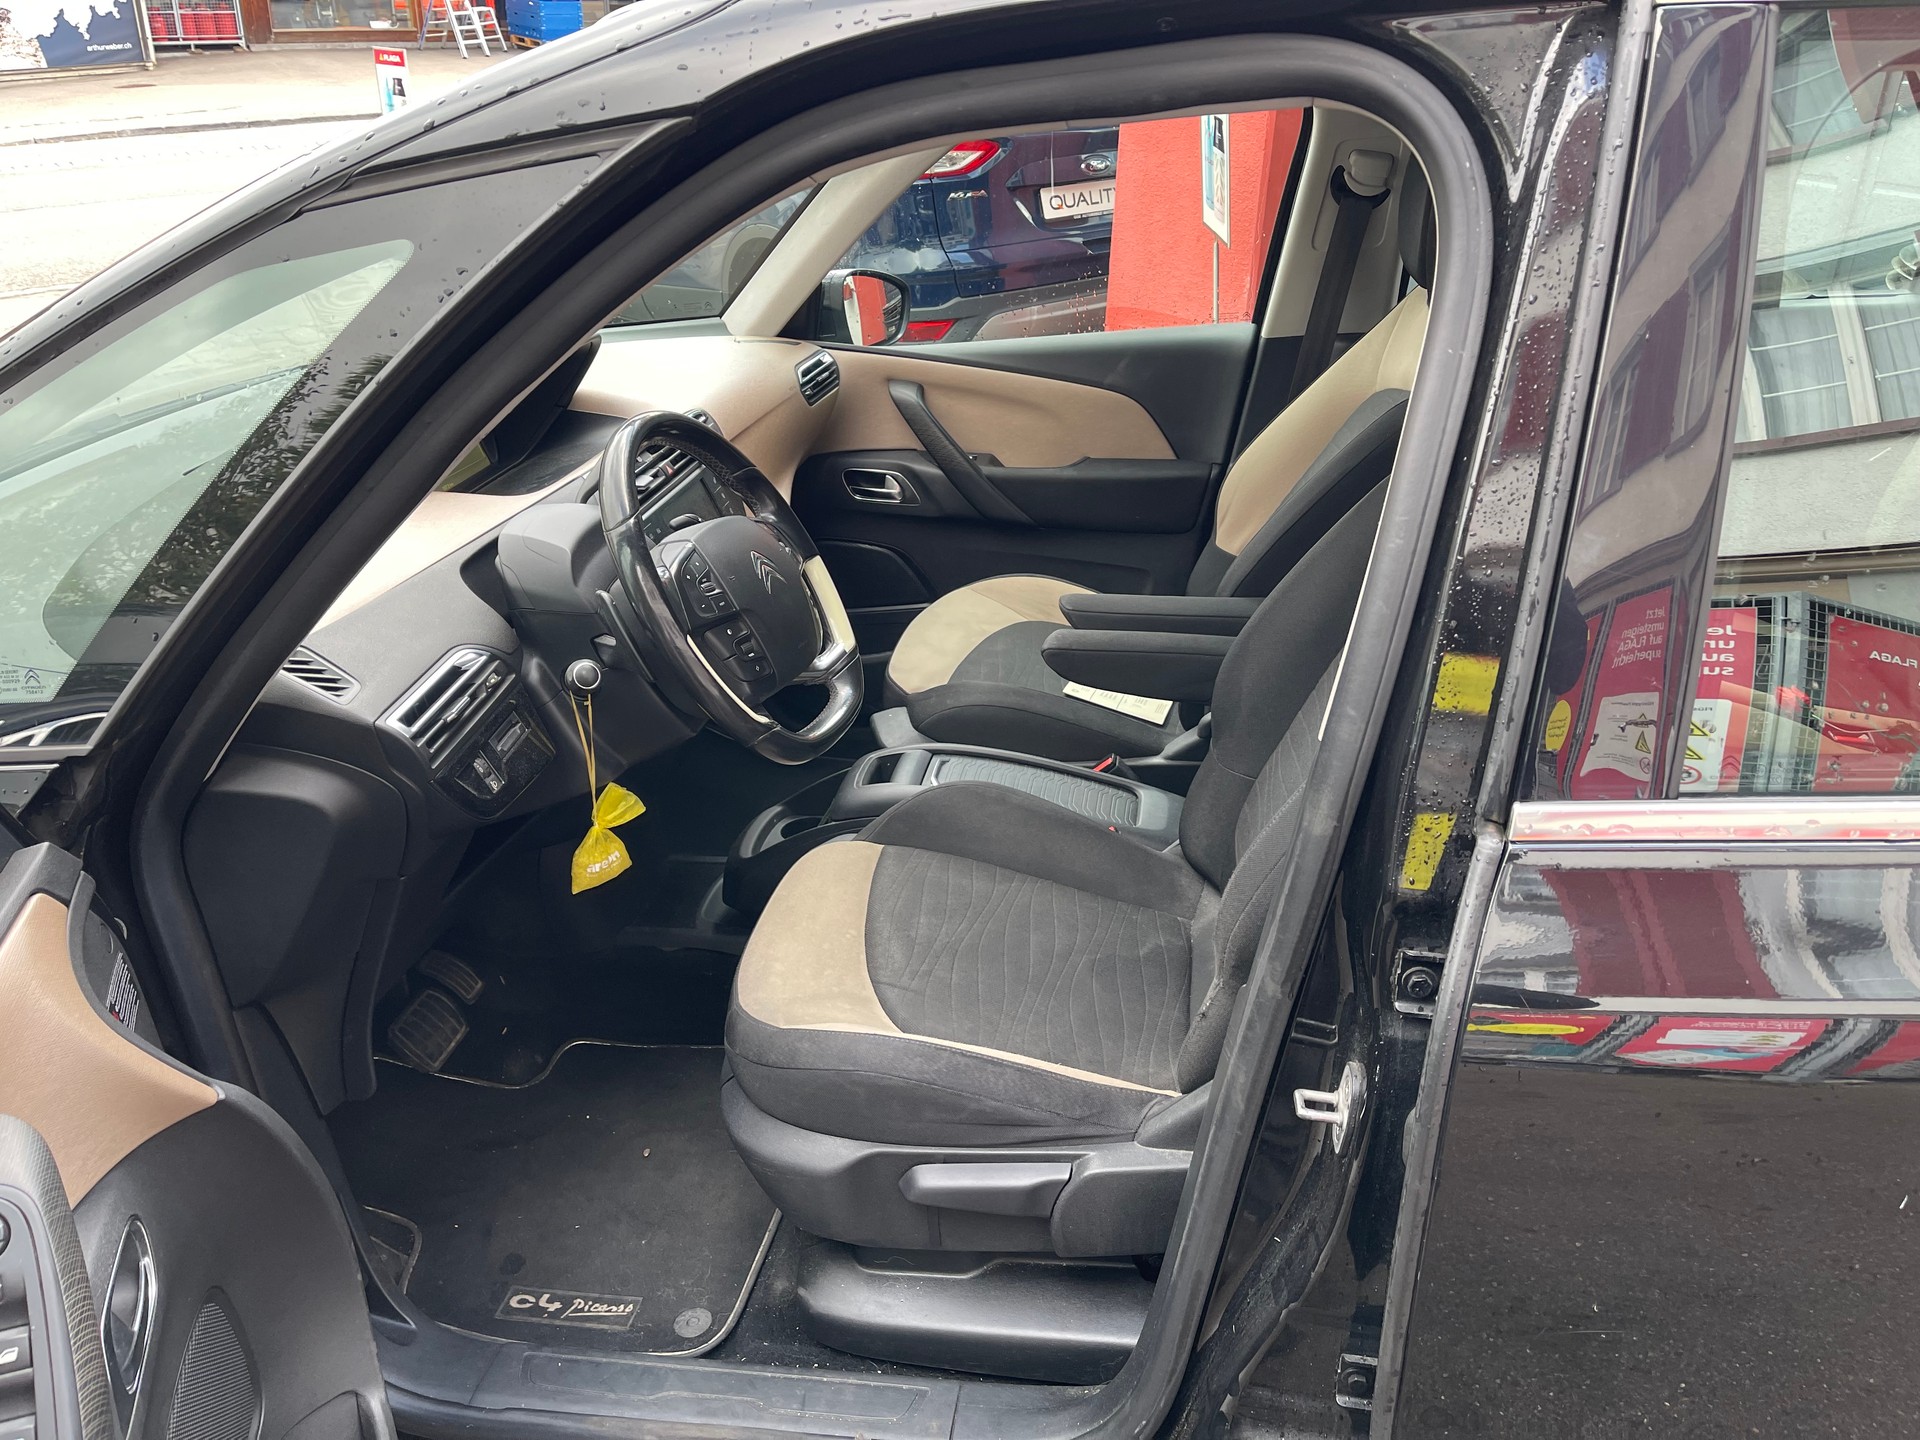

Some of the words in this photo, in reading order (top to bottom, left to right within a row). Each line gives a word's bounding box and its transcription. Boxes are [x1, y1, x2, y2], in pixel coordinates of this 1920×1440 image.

[86, 42, 133, 52] arthurweber.ch
[509, 1293, 563, 1315] C4
[560, 1298, 635, 1319] Picasso
